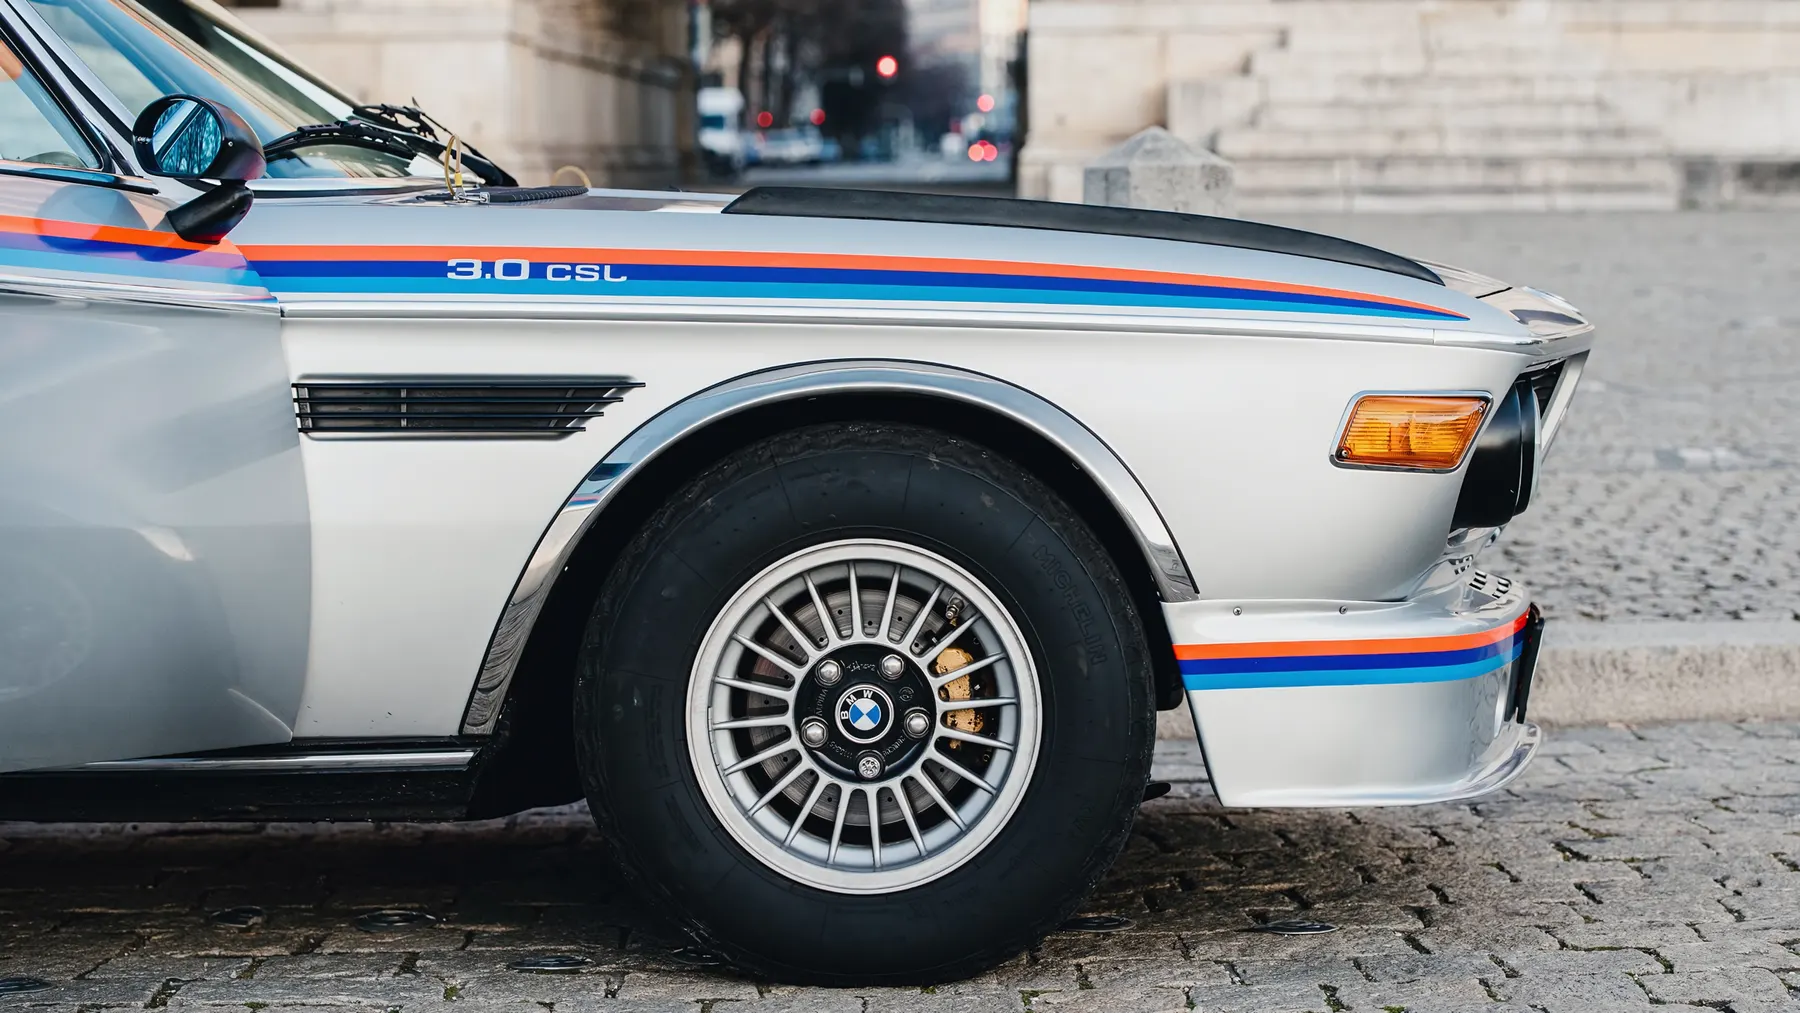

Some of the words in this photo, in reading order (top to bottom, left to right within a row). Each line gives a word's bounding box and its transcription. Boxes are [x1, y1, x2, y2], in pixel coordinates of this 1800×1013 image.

[447, 258, 530, 281] 3.0
[546, 264, 628, 282] CSL
[1032, 544, 1108, 666] MICHELIN
[840, 689, 874, 720] BMW
